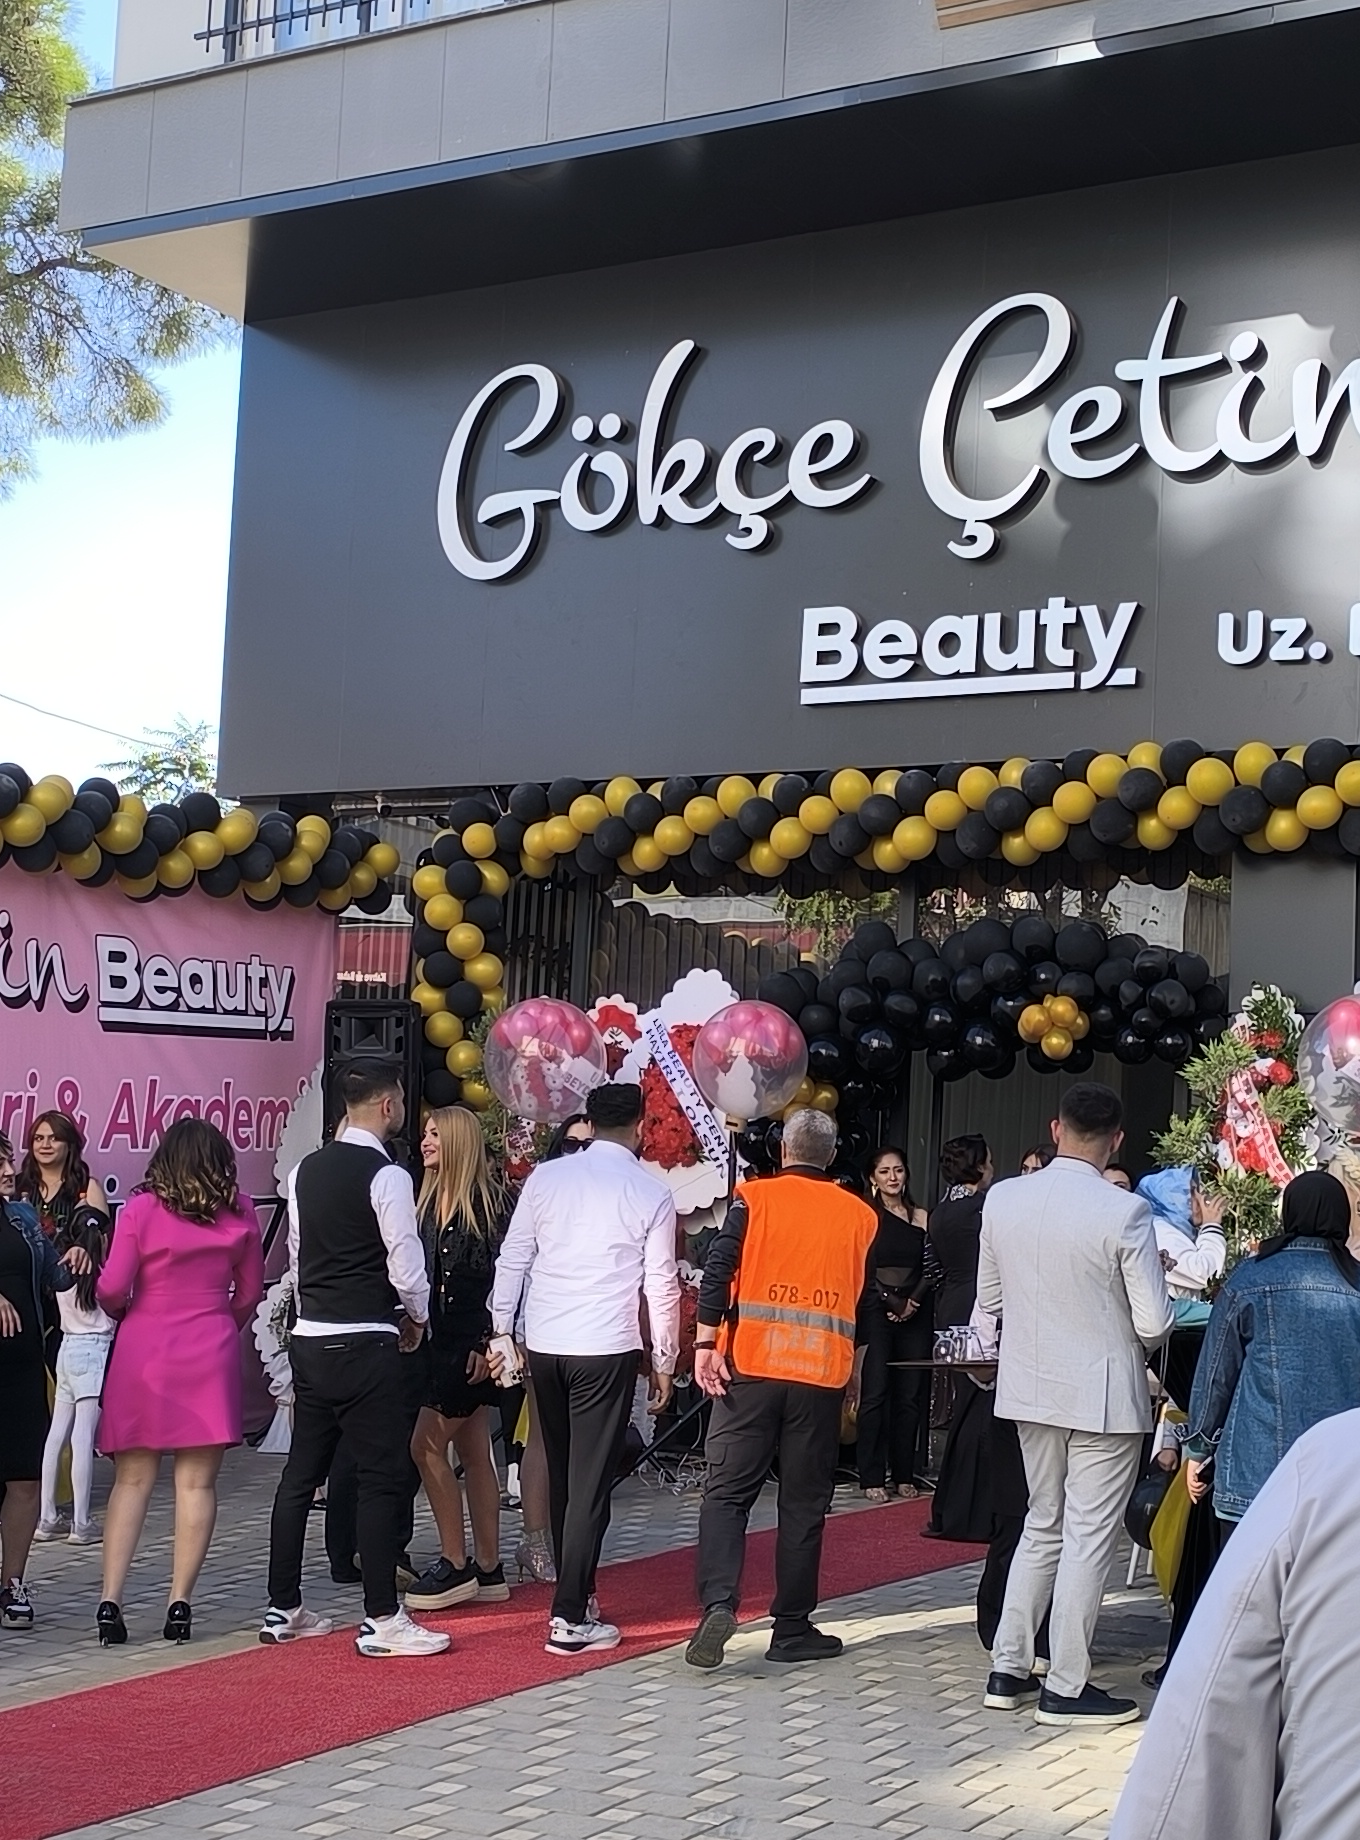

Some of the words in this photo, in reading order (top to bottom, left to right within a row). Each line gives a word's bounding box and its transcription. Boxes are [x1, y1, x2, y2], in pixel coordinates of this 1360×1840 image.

[438, 339, 876, 581] Gökçe
[800, 596, 1139, 690] Beauty
[1218, 609, 1330, 665] Uz.
[95, 935, 296, 1038] Beauty
[100, 1076, 308, 1151] Akdem
[666, 1050, 706, 1108] BEAUTY
[684, 1105, 726, 1180] OLSUN
